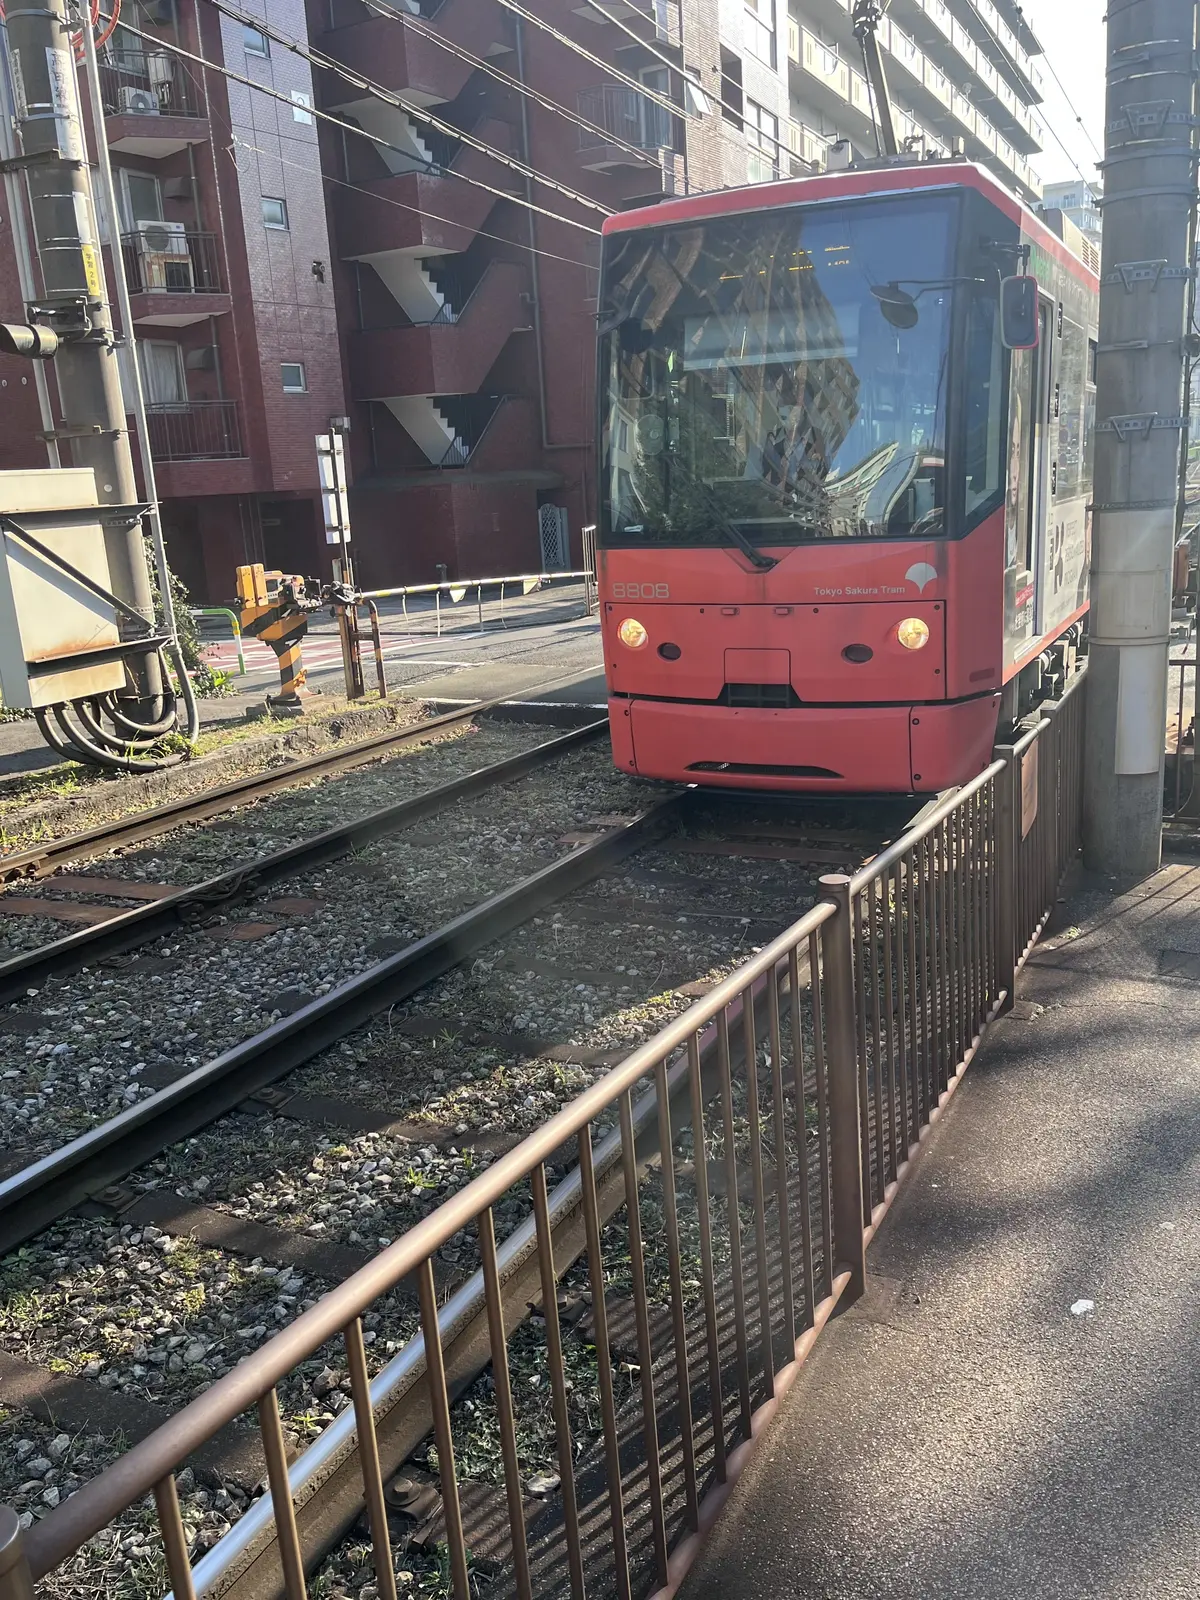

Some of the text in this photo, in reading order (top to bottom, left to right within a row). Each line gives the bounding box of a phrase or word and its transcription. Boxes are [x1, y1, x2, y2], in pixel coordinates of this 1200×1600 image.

[612, 582, 670, 599] 8808
[813, 584, 906, 597] Tokyo Sakura Tram
